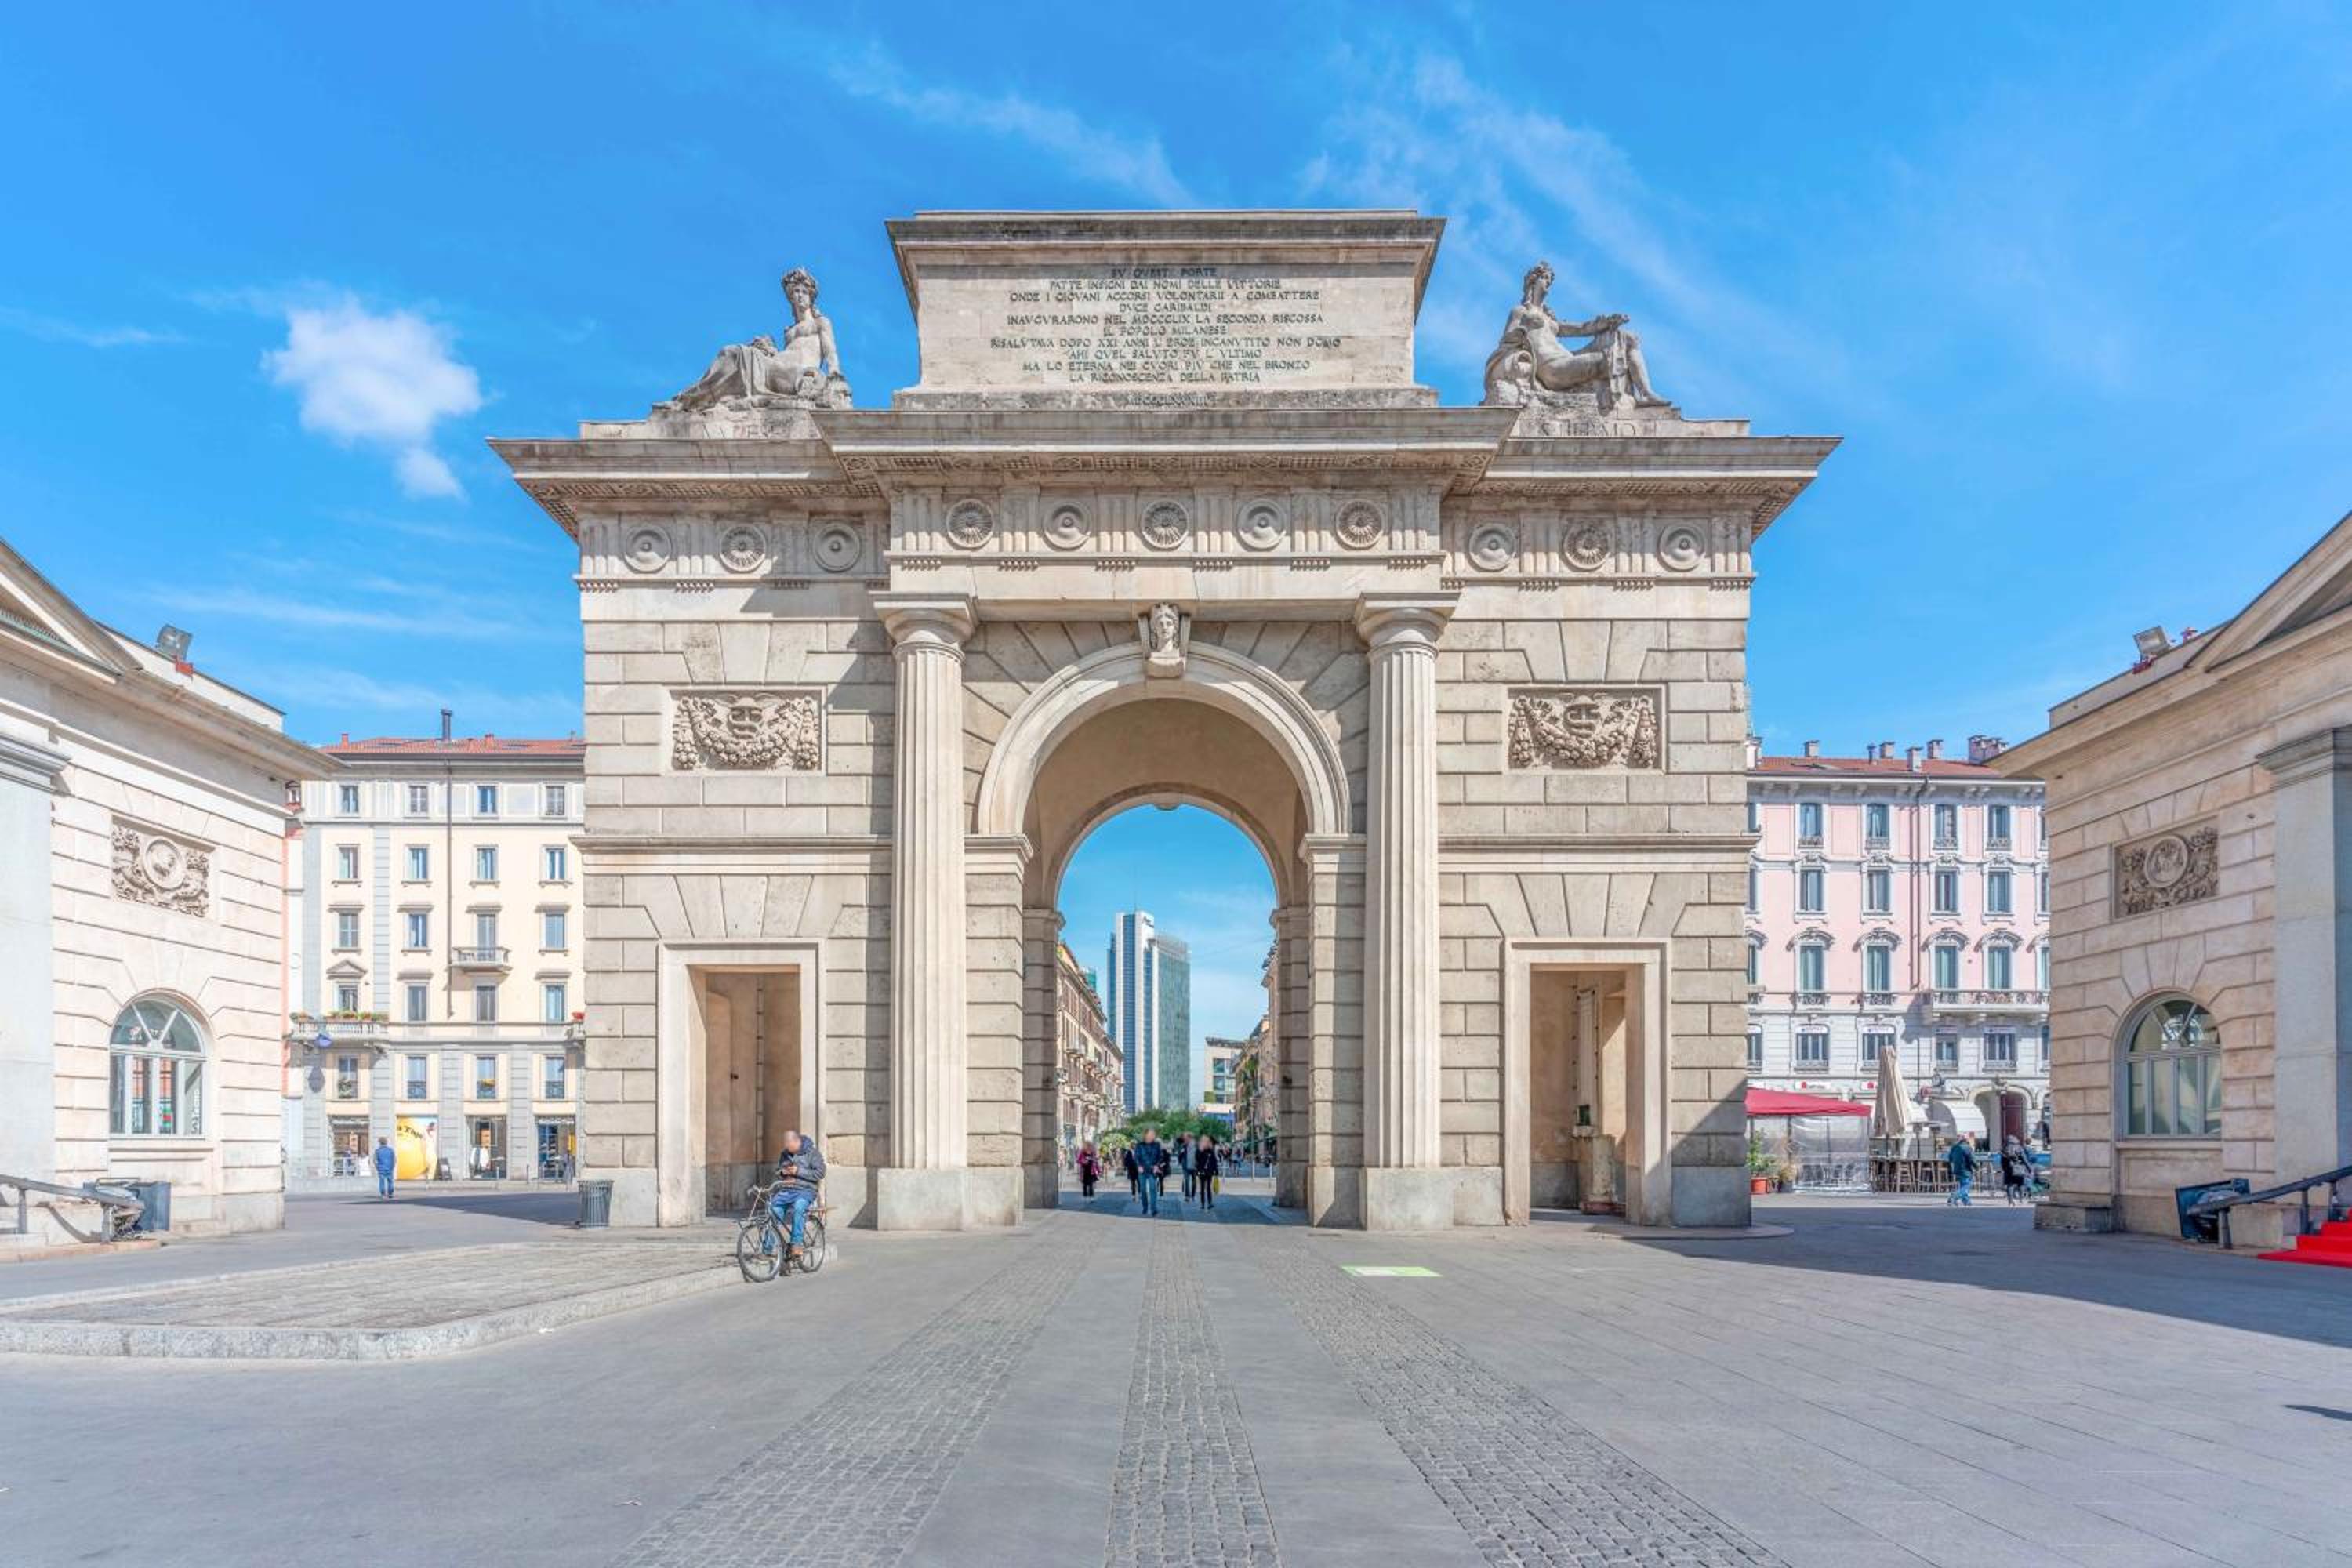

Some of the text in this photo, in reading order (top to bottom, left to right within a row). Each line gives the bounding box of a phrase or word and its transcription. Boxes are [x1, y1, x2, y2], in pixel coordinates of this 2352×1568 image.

[1131, 280, 1148, 289] DAI
[1153, 281, 1181, 289] NOMI
[1188, 280, 1221, 289] DELLE
[1228, 279, 1280, 289] VITTORIE
[1010, 291, 1319, 302] ONDE I GIOVANI ACCORSI VOLONTARII A COMBATTERE
[1119, 303, 1211, 312] DVCE GARIBALDI
[1007, 314, 1323, 325] INAVGVRARONO NEL MDCCCLIX LA SECONDA RISCOSSA
[1120, 326, 1167, 336] POPOLO
[1171, 325, 1226, 336] MILANESE
[1059, 338, 1091, 347] DOPO
[1098, 338, 1117, 347] XXI
[1123, 338, 1149, 347] ANNI
[1201, 338, 1270, 347] INCANVTITO
[1277, 337, 1301, 347] NON
[1068, 350, 1088, 360] AHI
[1094, 350, 1126, 360] QVEL
[1131, 349, 1178, 358] SALVTO
[1182, 349, 1200, 358] FV
[1219, 349, 1261, 358] VLTIMO
[1022, 361, 1040, 371] MA
[1047, 361, 1062, 371] LO
[1068, 361, 1113, 371] ETERNA
[1210, 361, 1232, 370] CHE
[1239, 360, 1261, 369] NEL
[1265, 360, 1310, 369] BRONZO
[1069, 372, 1261, 383] LA RICONOSCENZA DELLA PATRIA
